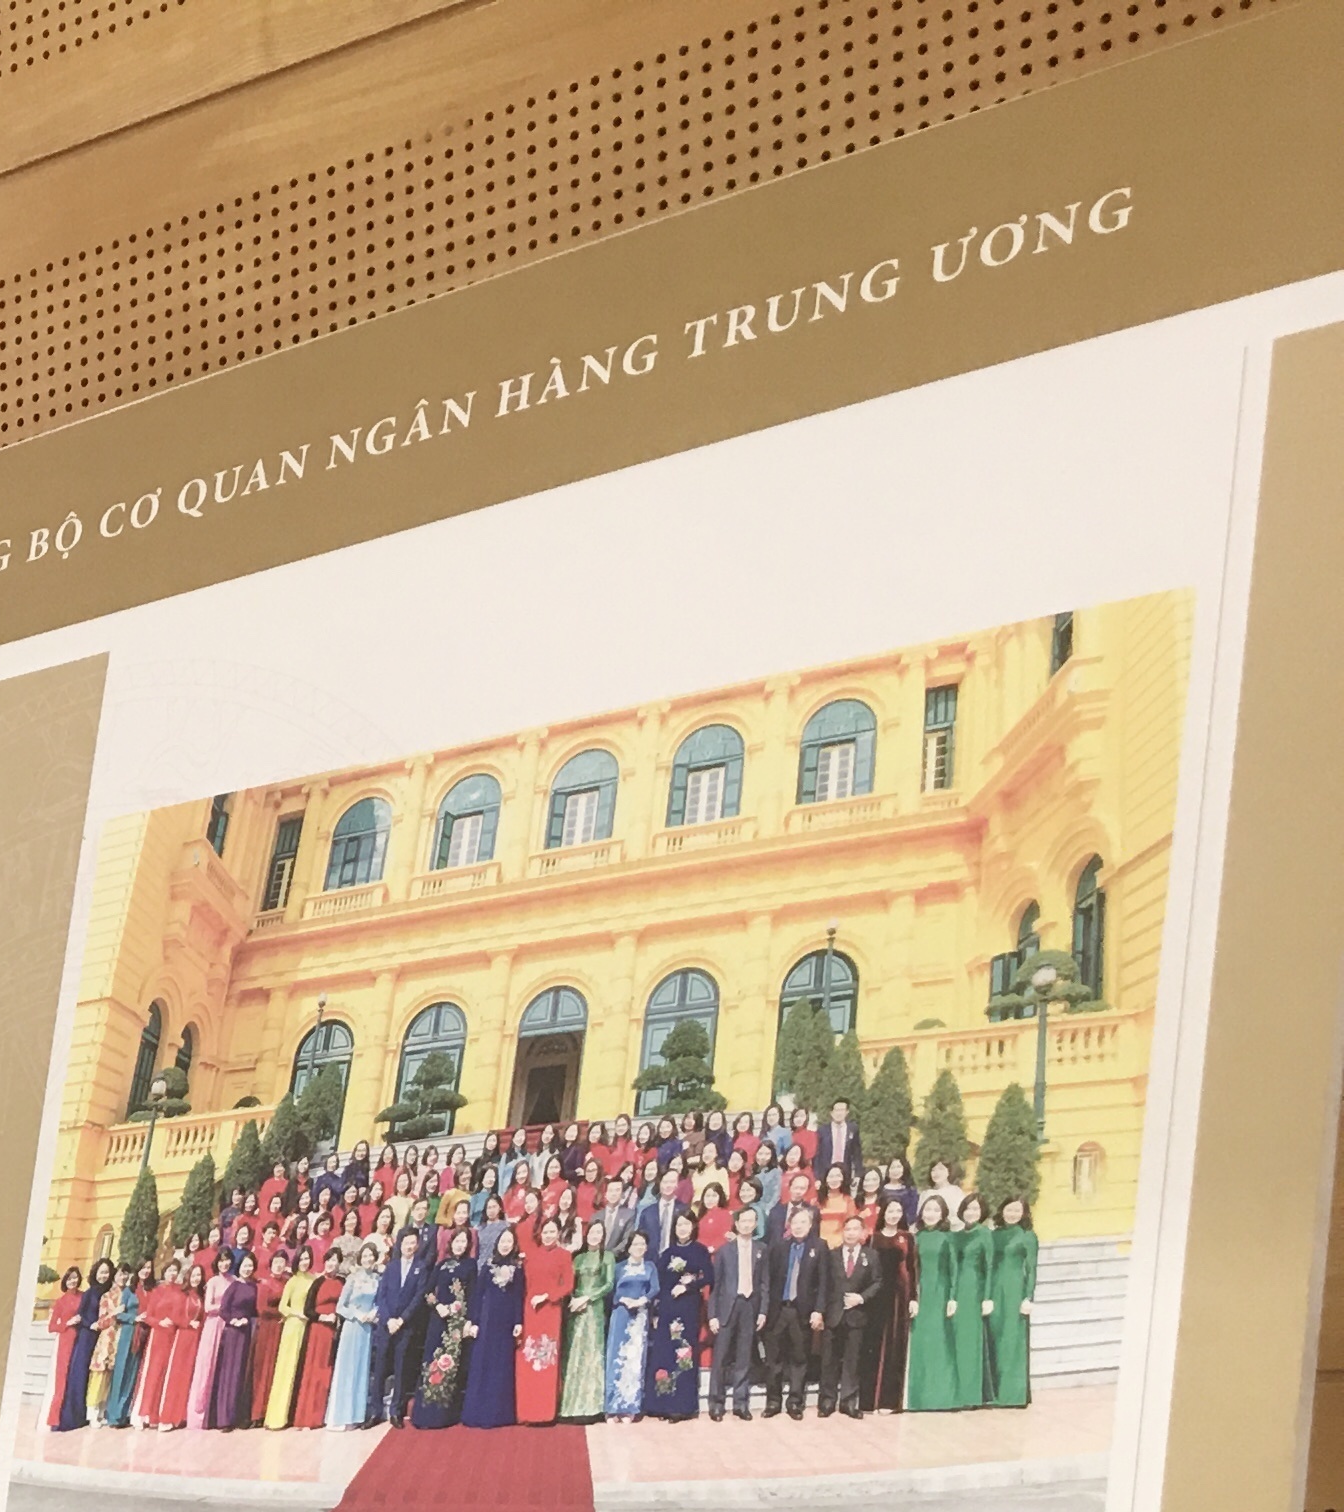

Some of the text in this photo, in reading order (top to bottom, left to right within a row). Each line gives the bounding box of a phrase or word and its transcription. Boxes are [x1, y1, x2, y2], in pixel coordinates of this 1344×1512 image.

[27, 511, 83, 562] BỘ
[99, 487, 162, 538] CƠ
[177, 444, 308, 518] QUAN
[326, 391, 475, 470] NGÂN
[496, 334, 658, 418] HÀNG
[684, 258, 899, 359] TRUNG
[932, 187, 1132, 283] ƯƠNG
